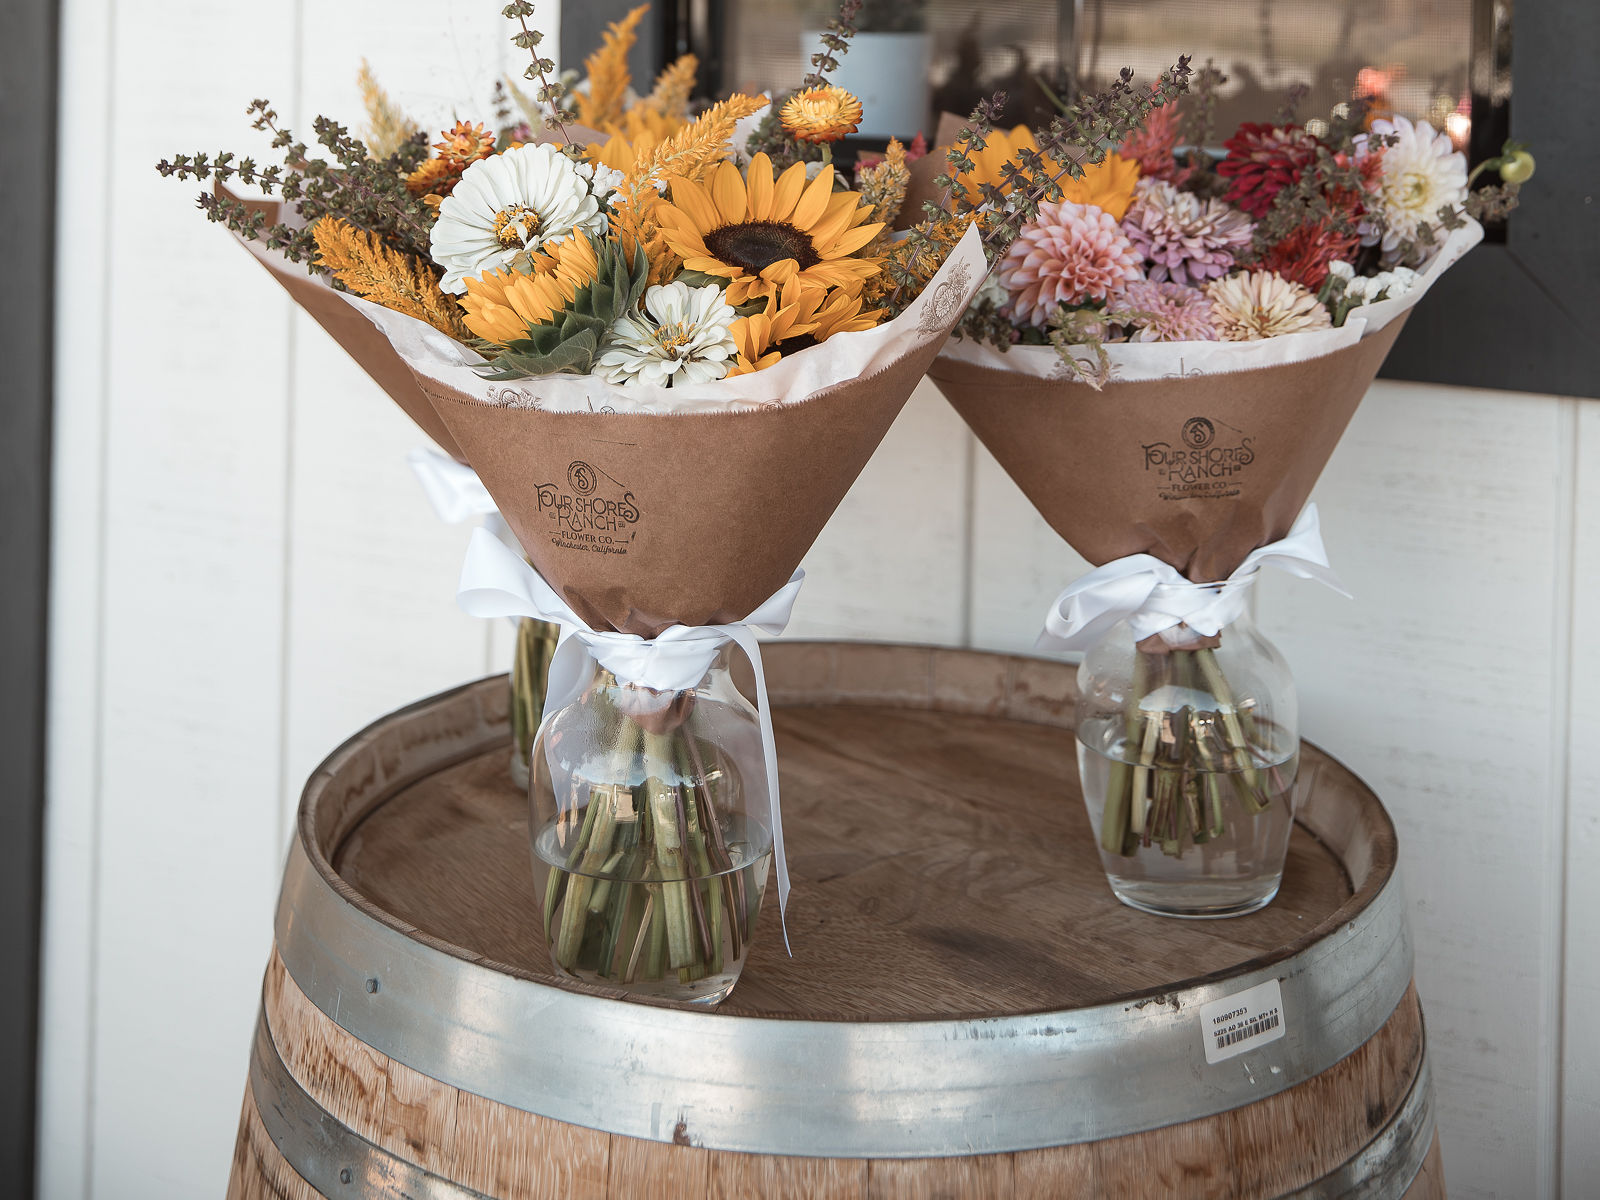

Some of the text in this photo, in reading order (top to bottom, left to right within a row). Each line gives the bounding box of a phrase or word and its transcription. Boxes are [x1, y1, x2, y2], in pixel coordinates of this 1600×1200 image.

[1142, 437, 1255, 470] FOUR SHORES
[1168, 461, 1232, 483] RANCH
[1172, 483, 1210, 491] FLOWER
[533, 483, 640, 523] FOUR SHORES
[557, 504, 617, 532] RANCH
[561, 531, 615, 545] FLOWER CO.
[591, 544, 628, 555] California
[1213, 1007, 1248, 1024] 180907353
